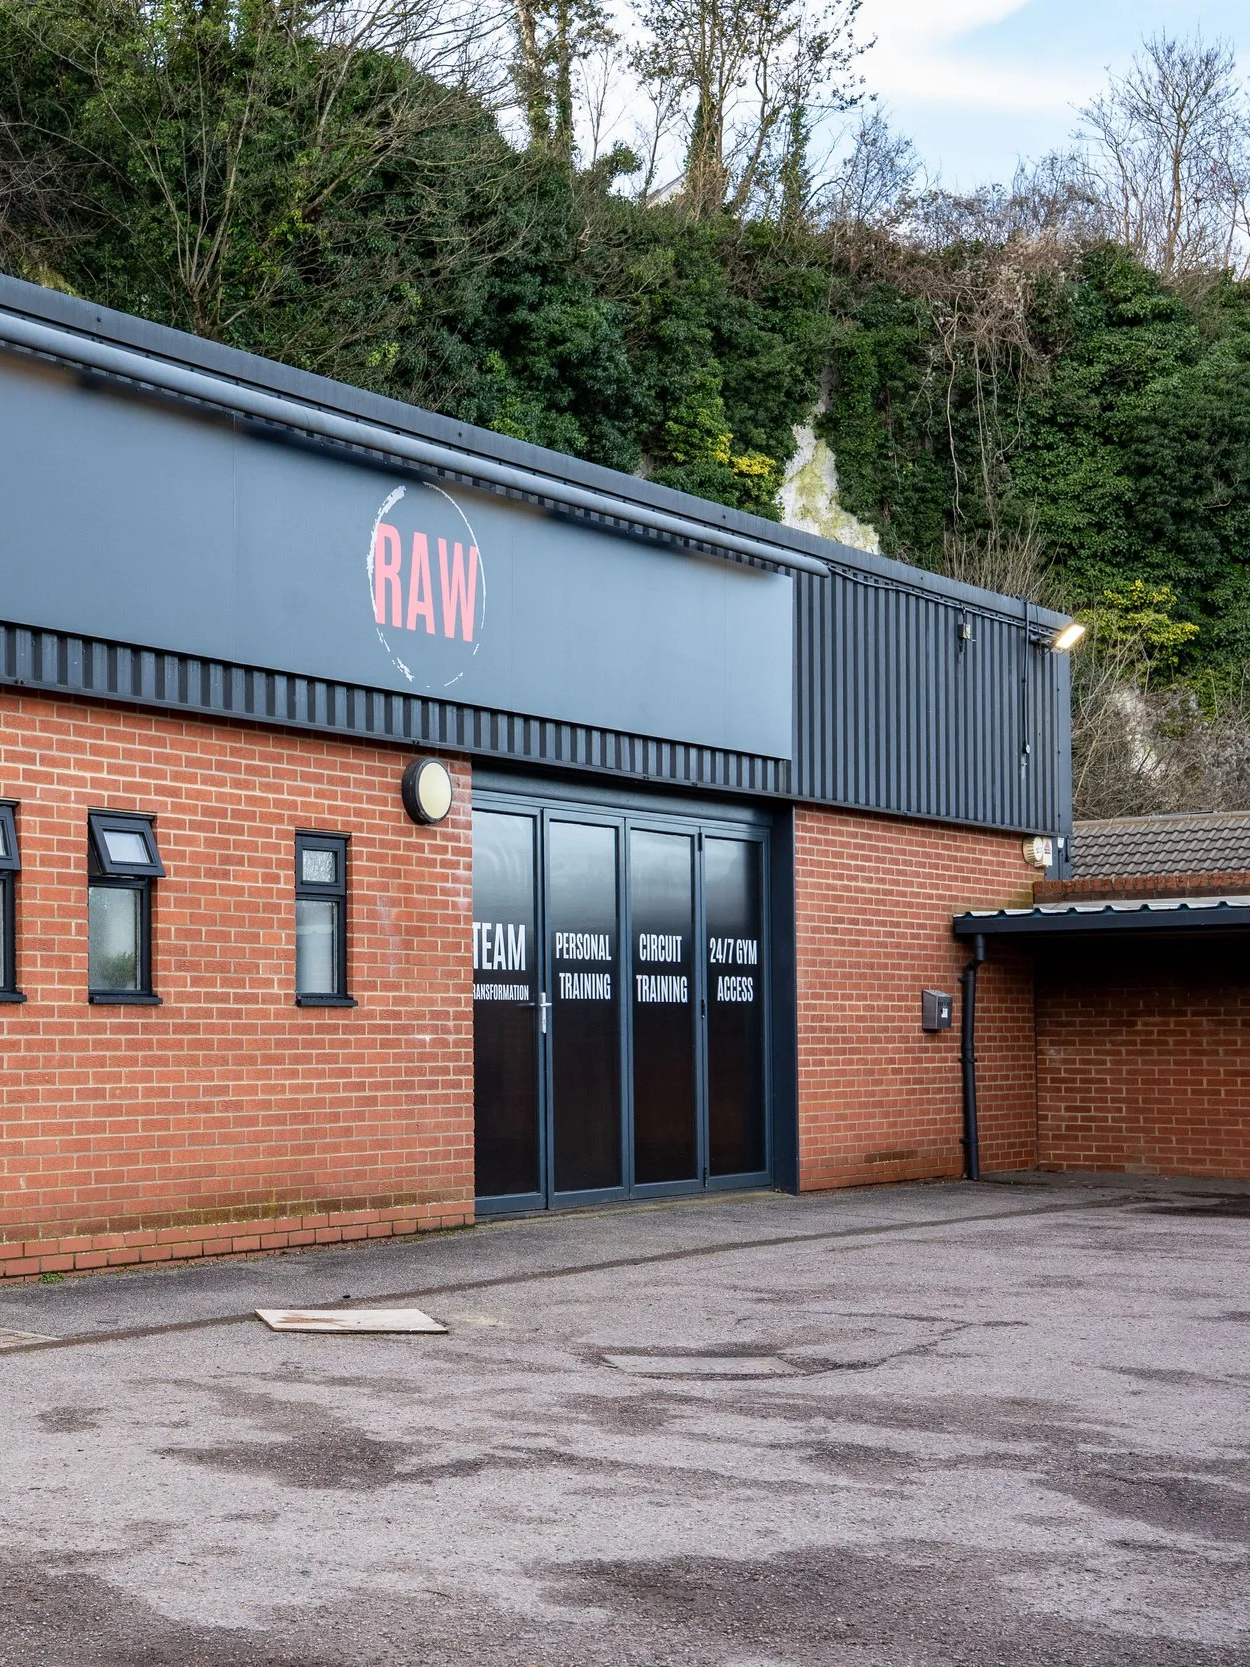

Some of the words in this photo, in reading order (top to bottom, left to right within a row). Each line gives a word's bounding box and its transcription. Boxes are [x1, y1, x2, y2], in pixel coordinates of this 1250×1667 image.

[375, 523, 478, 642] RAW
[472, 922, 526, 971] TEAM
[555, 932, 612, 961] PERSONAL
[639, 933, 682, 962] CIRCUIT
[710, 937, 734, 964] 24/7
[736, 939, 757, 965] GYM
[473, 983, 529, 1001] RANSFORMATION
[559, 972, 611, 1000] TRAINING
[636, 974, 688, 1003] TRAINING
[717, 976, 754, 1002] ACCESS
